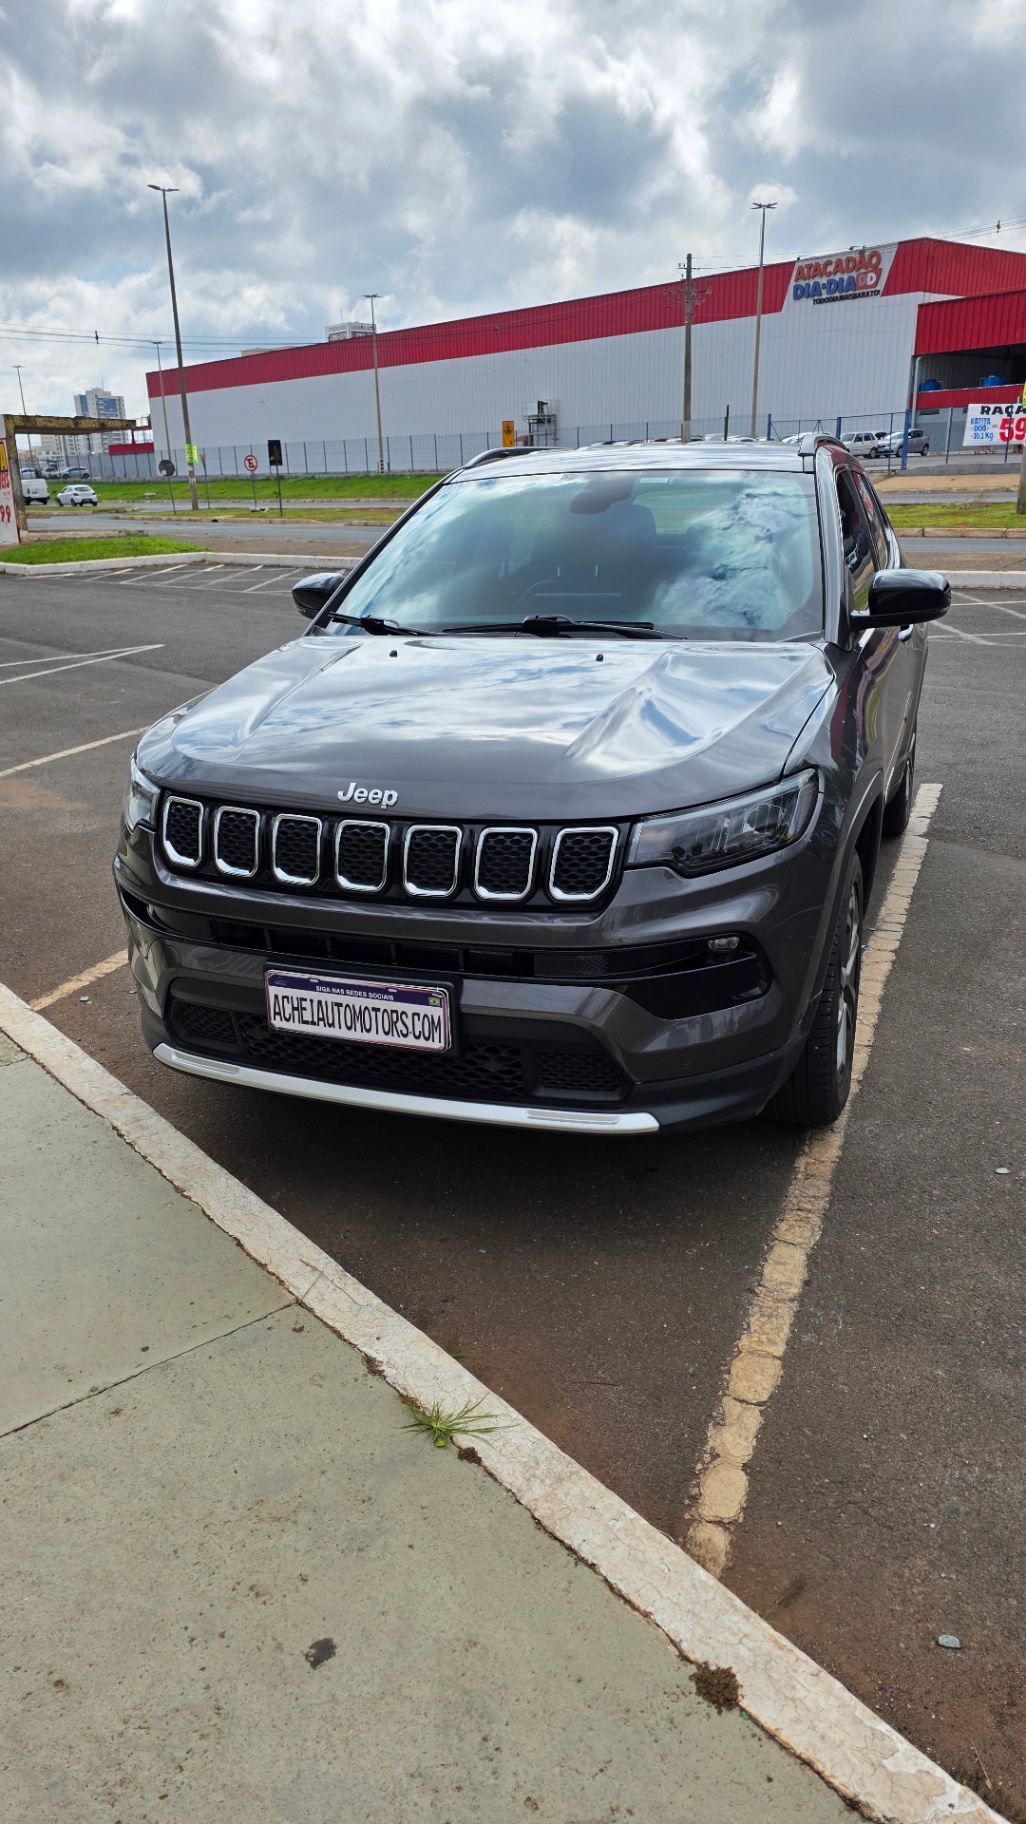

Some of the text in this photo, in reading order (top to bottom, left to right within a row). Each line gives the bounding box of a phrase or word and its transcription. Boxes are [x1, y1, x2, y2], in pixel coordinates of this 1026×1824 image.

[794, 250, 881, 281] ATACADÃO
[337, 782, 399, 809] Jeep
[315, 985, 394, 1000] SIGA NAS REDES SOCIAIS
[273, 994, 442, 1043] ACHEIAUTOMOTORS.COM
